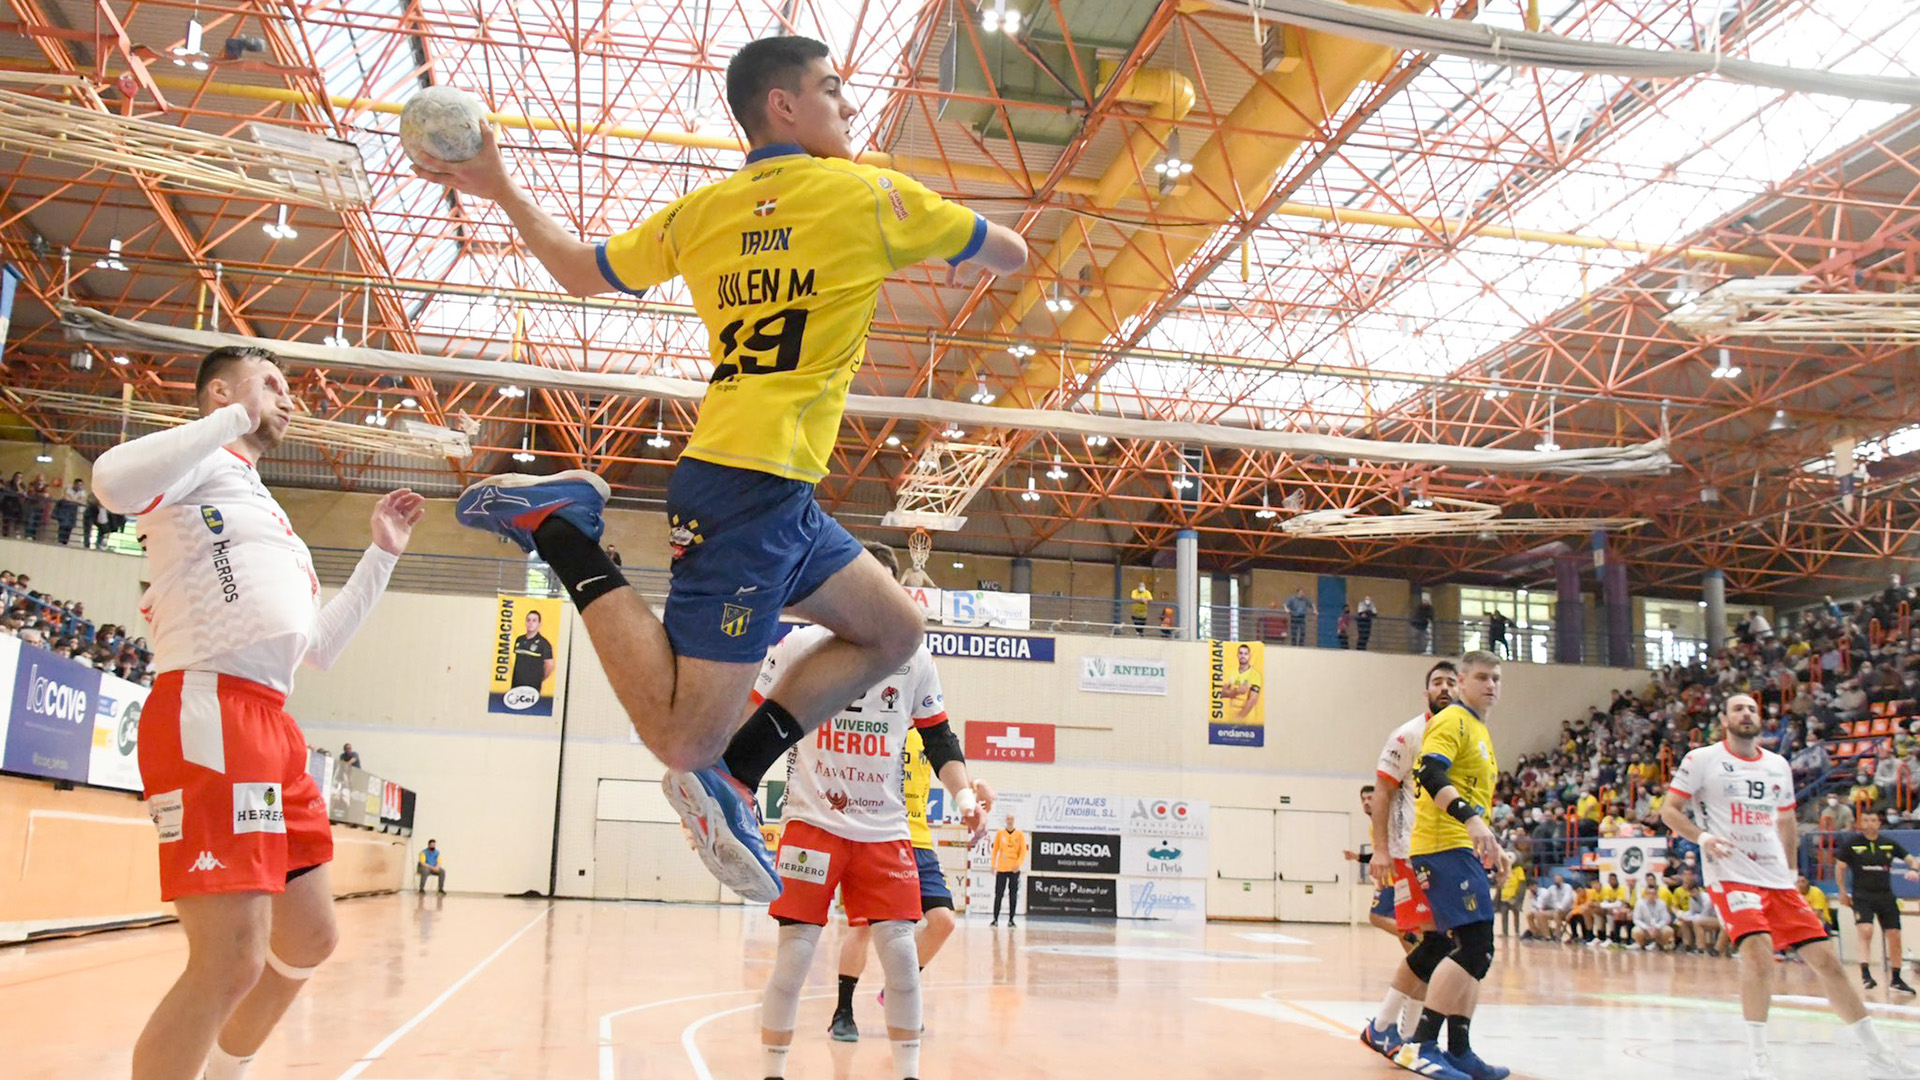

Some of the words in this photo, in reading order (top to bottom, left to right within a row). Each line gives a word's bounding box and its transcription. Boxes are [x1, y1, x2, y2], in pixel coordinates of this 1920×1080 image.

[740, 227, 793, 256] IRUN
[718, 268, 780, 310] JULEN
[786, 268, 817, 302] M.
[981, 580, 999, 590] WC
[495, 599, 514, 682] FORMACION
[923, 633, 1031, 659] IROLDEGIA
[1113, 665, 1165, 677] ANTEDI
[834, 718, 889, 734] VIVEROS
[1217, 729, 1256, 739] endanea
[817, 716, 891, 757] HEROL
[986, 748, 1035, 758] FICOBA
[1745, 780, 1765, 799] 19
[1067, 797, 1107, 807] ONTAJES
[1040, 842, 1111, 858] BIDASSOA
[779, 862, 825, 877] HERRERO
[1146, 862, 1157, 872] La
[1161, 862, 1183, 873] Perla
[1035, 880, 1068, 897] Reflejo
